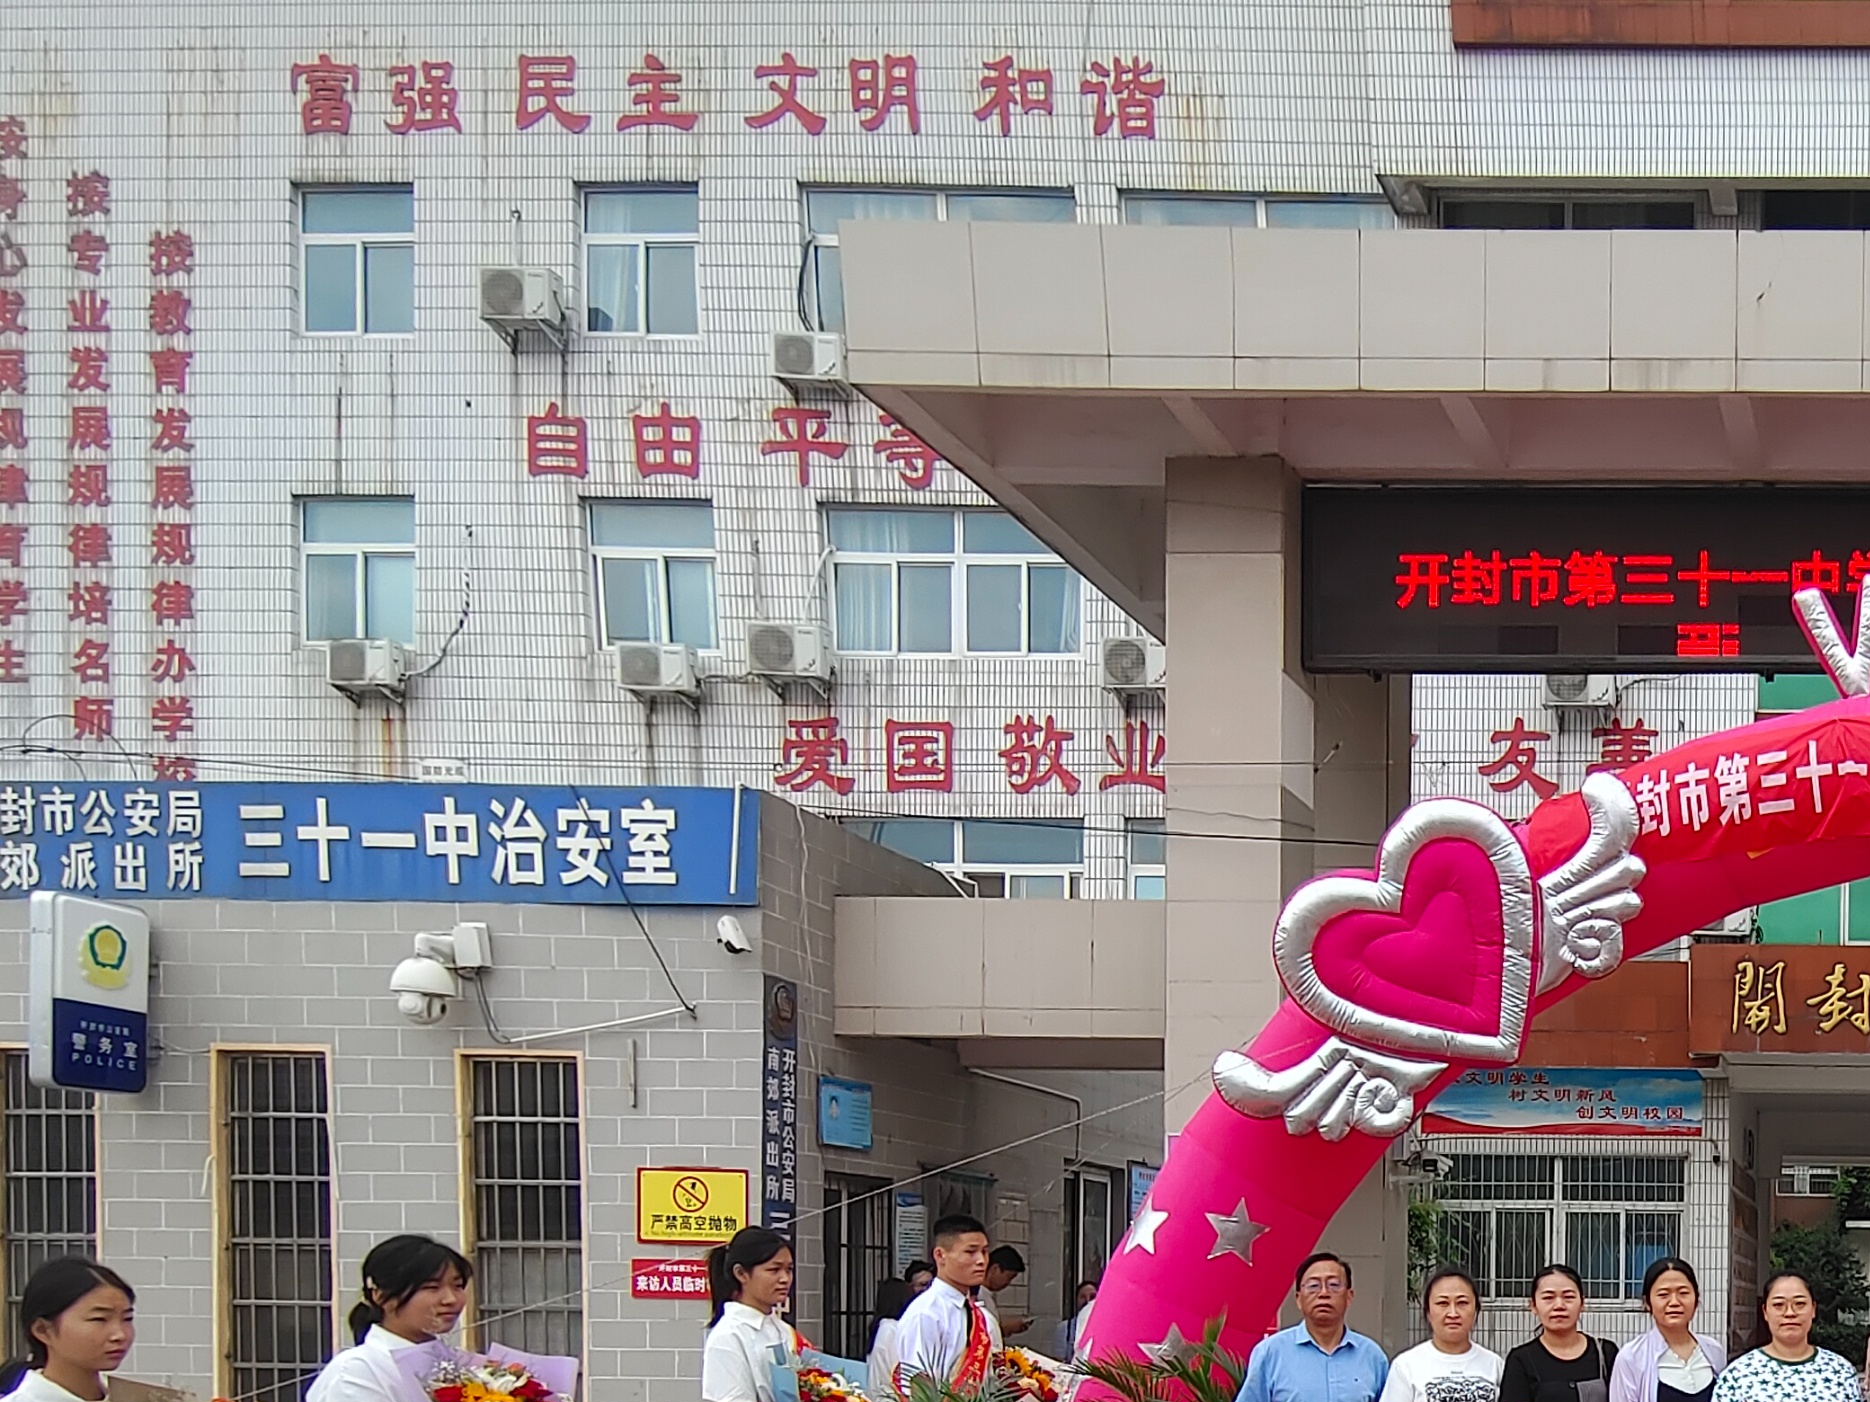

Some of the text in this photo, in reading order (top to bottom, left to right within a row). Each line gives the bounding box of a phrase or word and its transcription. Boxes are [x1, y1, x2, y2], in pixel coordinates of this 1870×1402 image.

[291, 52, 1166, 139] 富强民主文明和谐
[66, 170, 113, 742] 按专业发展规律培名师
[774, 715, 1166, 797] 爱国敬业
[0, 786, 203, 839] 封市公安局
[0, 840, 204, 892] 郊派出所
[237, 796, 679, 887] 三十一中治安室
[71, 1032, 138, 1058] 警务室
[71, 1053, 137, 1071] POLICE
[1452, 1070, 1551, 1086] 文明学生
[1508, 1088, 1617, 1103] 树文明新风
[781, 1048, 796, 1204] 开封市公安局
[1576, 1106, 1684, 1120] 创文明校园
[651, 1214, 737, 1232] 严禁高空抛物
